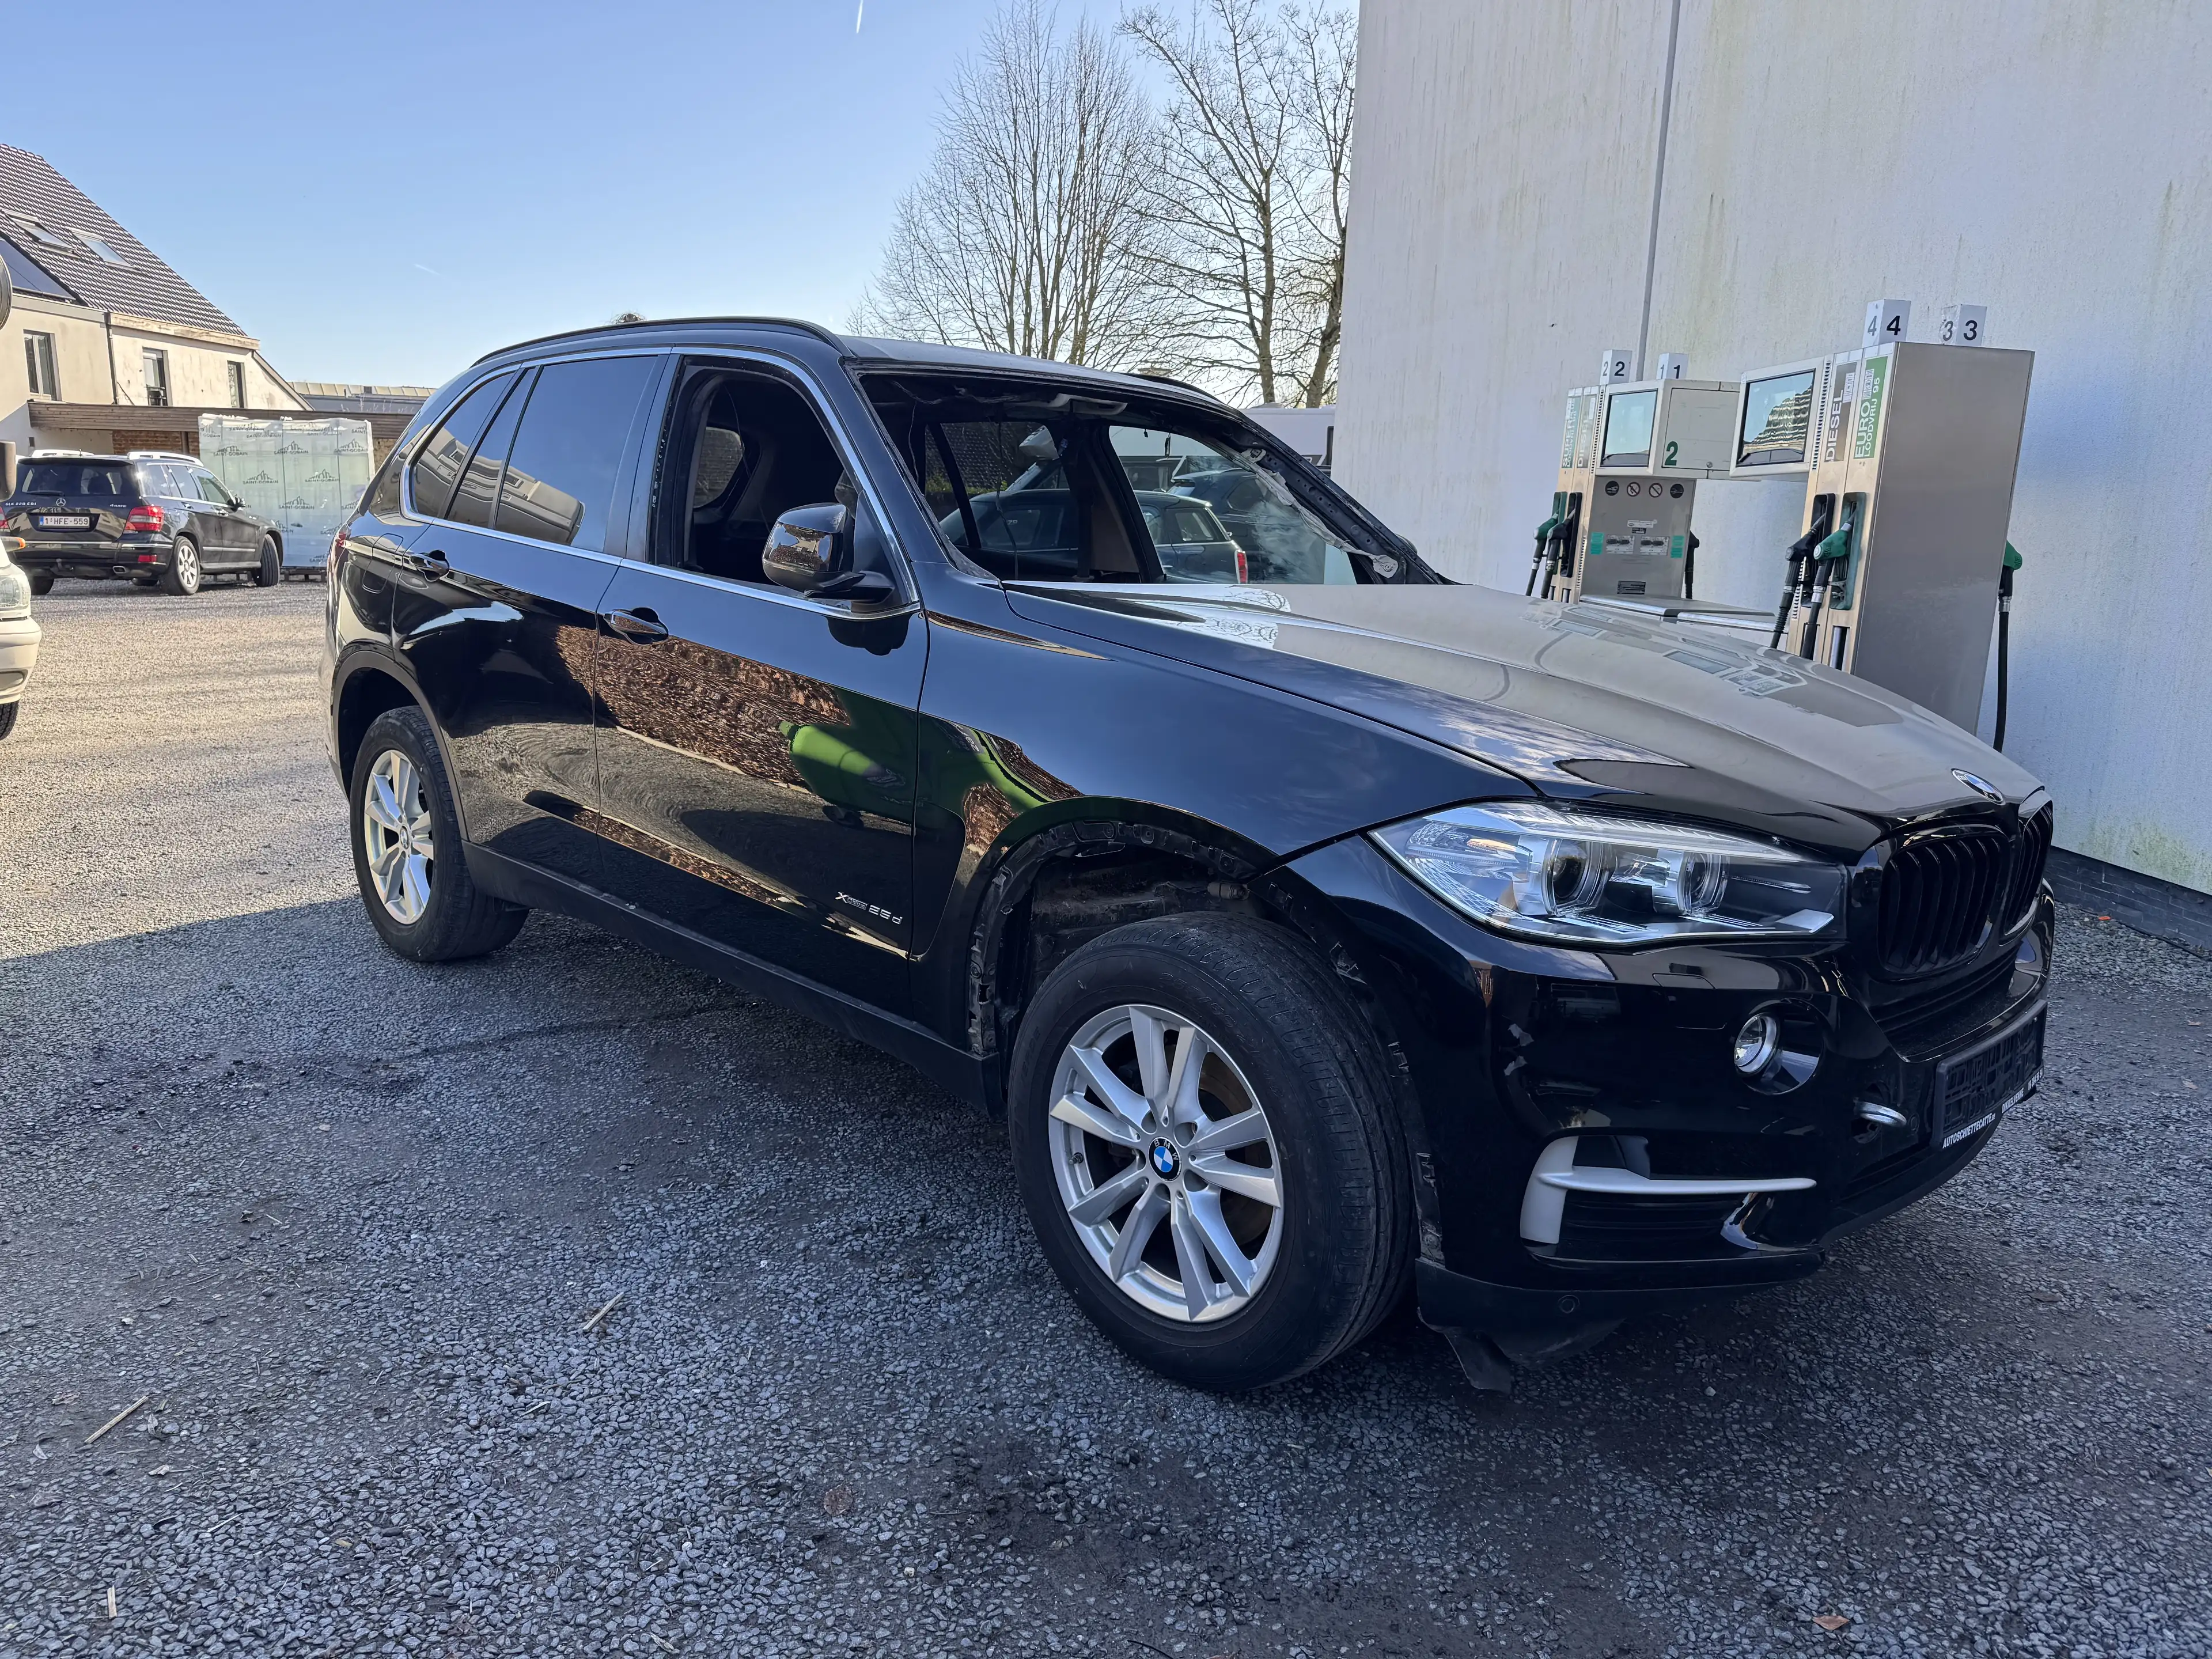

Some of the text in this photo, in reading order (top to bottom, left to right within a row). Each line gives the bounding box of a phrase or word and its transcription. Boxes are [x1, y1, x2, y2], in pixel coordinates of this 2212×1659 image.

[1887, 316, 1901, 335] 4
[1963, 320, 1978, 340] 3
[1614, 361, 1625, 376] 2
[1673, 365, 1680, 378] 1
[1825, 390, 1843, 461] DIESEL
[1864, 398, 1877, 457] LOODVRIJ
[1872, 377, 1880, 392] 95
[1854, 402, 1870, 458] EURO
[1665, 441, 1679, 466] 2
[1154, 1139, 1179, 1160] BMW
